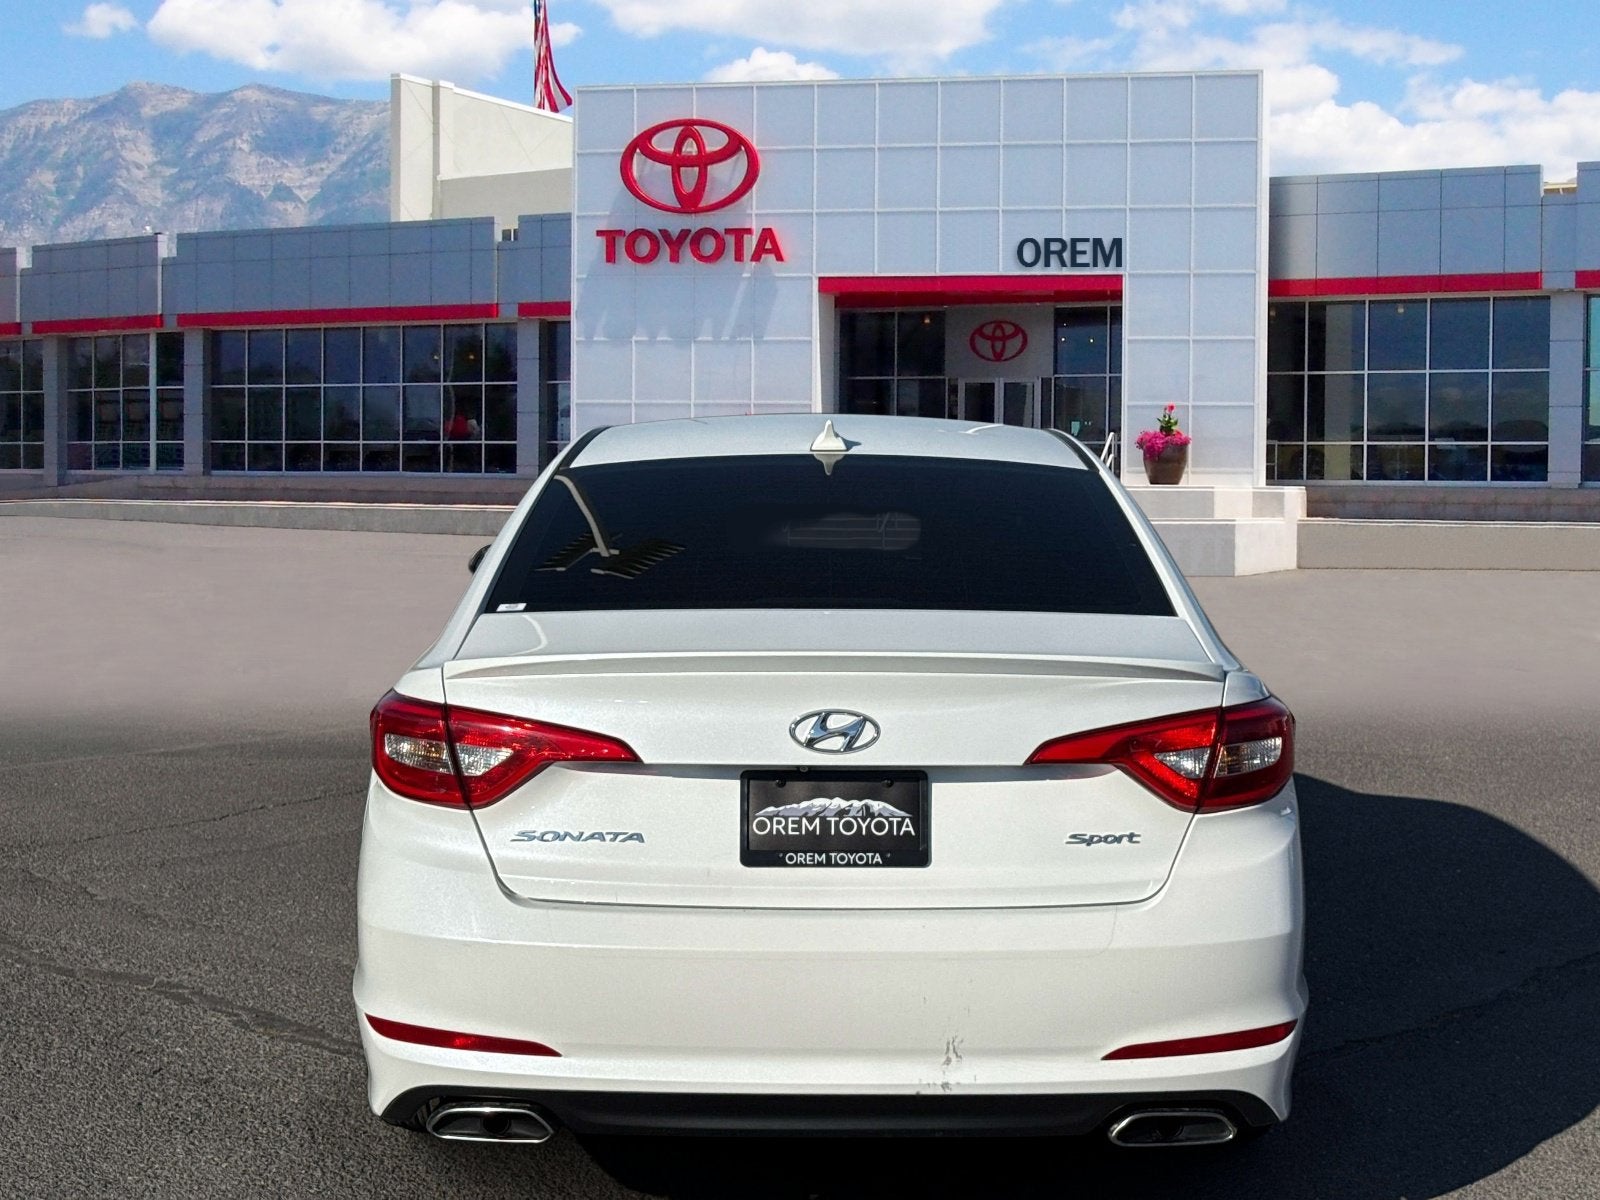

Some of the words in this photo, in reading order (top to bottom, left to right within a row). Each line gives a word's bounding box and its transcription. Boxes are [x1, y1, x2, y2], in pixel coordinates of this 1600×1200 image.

[596, 227, 785, 264] TOYOTA
[1016, 237, 1123, 269] OREM
[752, 816, 820, 836] OREM
[826, 816, 916, 836] TOYOTA
[510, 829, 646, 844] SONATA
[1065, 832, 1142, 847] Sport
[785, 852, 826, 865] OREM
[828, 852, 883, 865] TOYOTA
